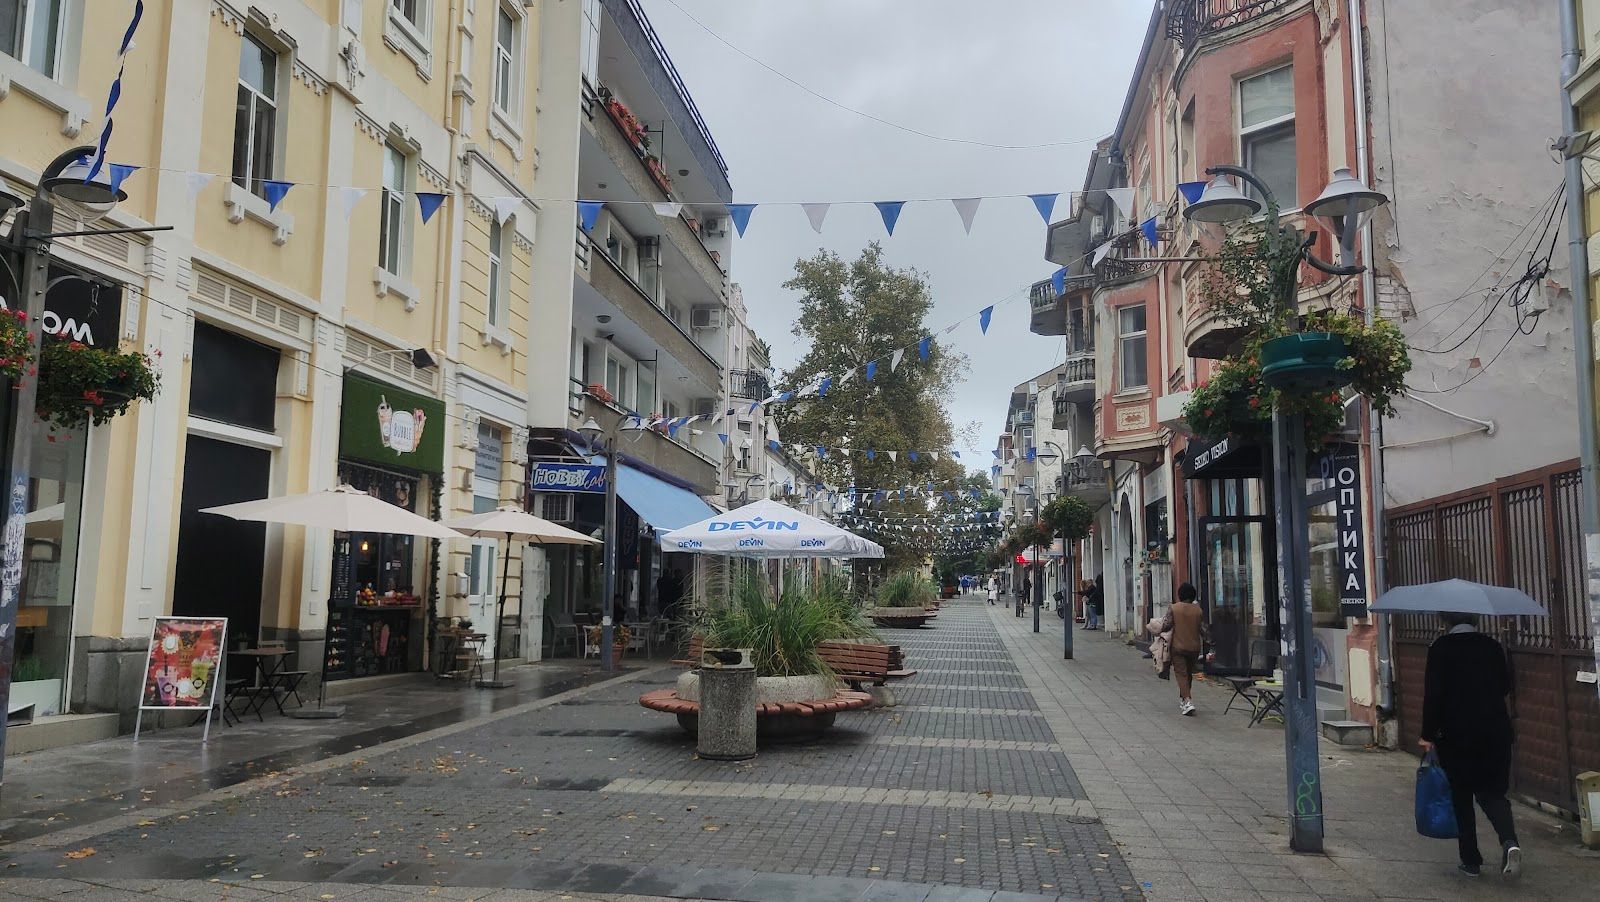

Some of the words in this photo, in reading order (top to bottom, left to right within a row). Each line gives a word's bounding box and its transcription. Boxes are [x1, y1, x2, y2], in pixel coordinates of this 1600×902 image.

[1195, 450, 1210, 470] SEIKO
[1210, 437, 1229, 460] VISION
[533, 468, 590, 487] HOBBY
[708, 517, 799, 532] DEVIN
[1338, 467, 1360, 591] ОПТИКА
[678, 540, 702, 548] DEVIN
[739, 538, 764, 547] DEVIN
[801, 538, 826, 547] DEVIN
